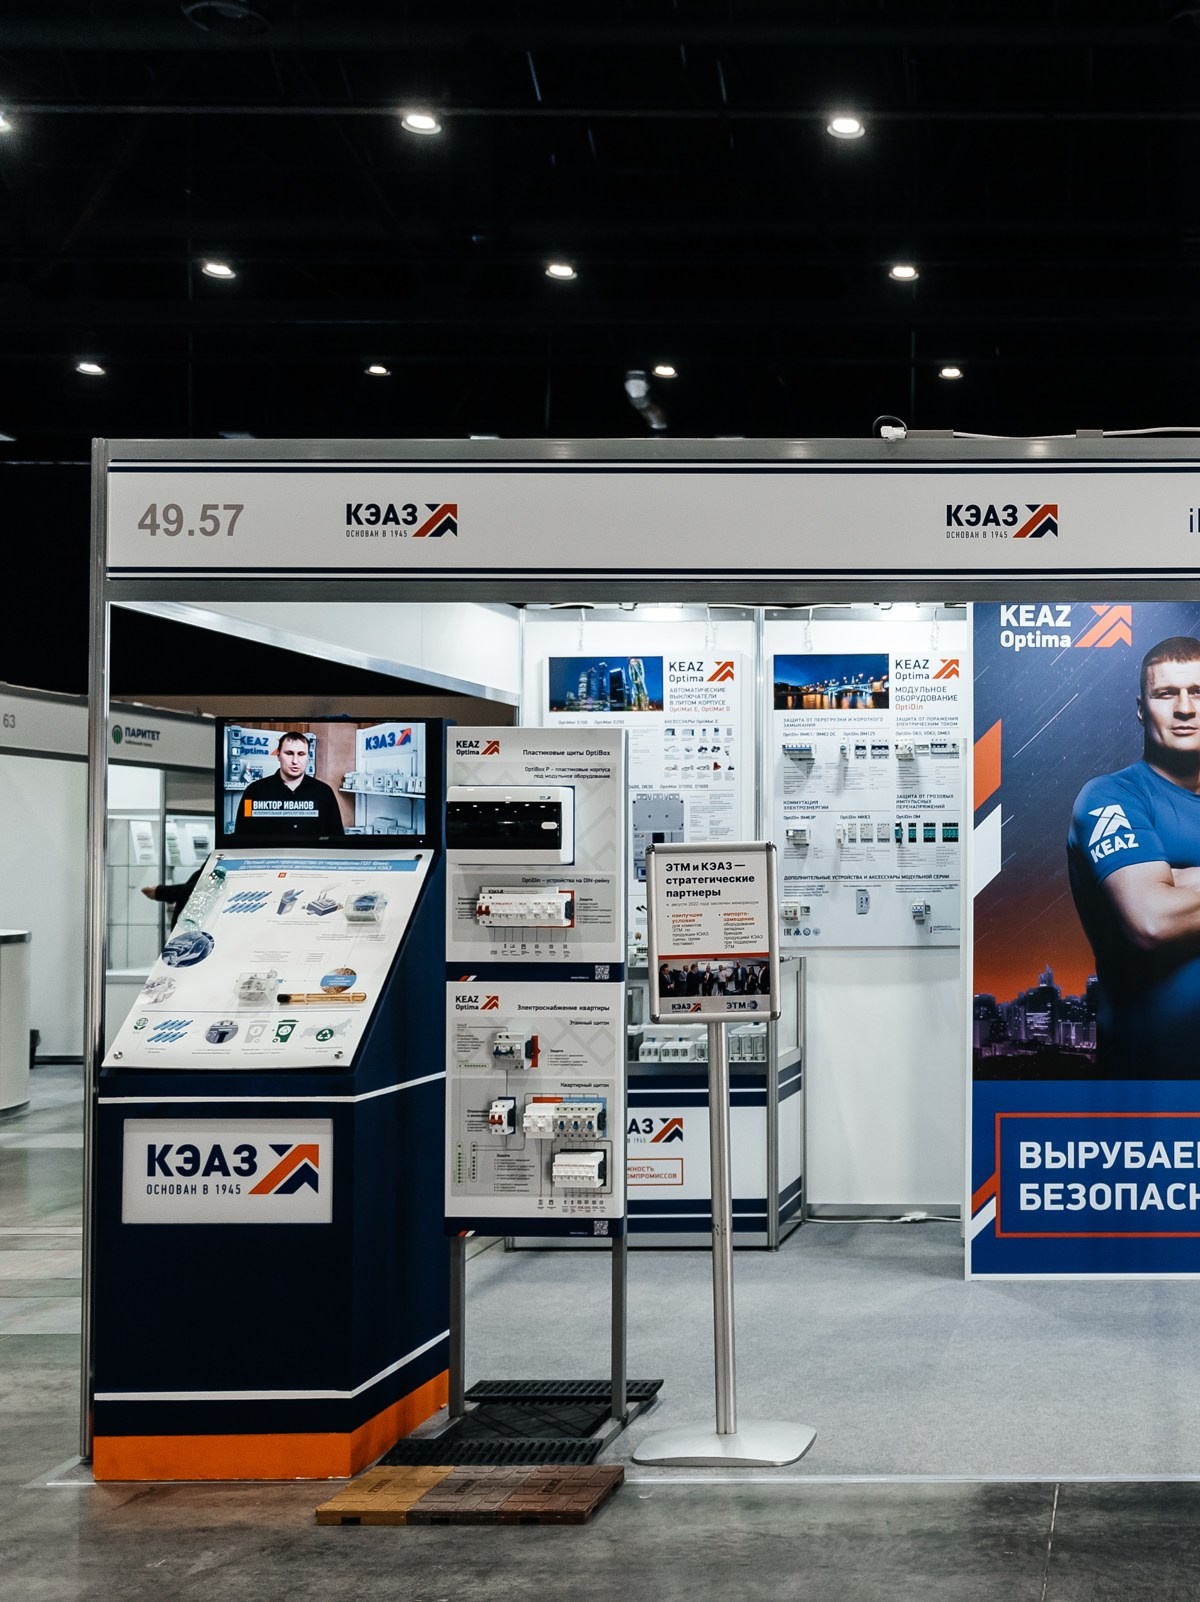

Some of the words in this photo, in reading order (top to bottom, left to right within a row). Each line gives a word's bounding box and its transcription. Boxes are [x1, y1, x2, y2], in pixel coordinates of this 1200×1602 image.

[137, 503, 245, 537] 49.57
[345, 503, 418, 526] КЭАЗ
[946, 504, 1018, 527] КЭАЗ
[345, 530, 378, 538] ОСНОВАН
[381, 530, 387, 538] В
[390, 530, 408, 538] 1945
[946, 531, 980, 539] ОСНОВАН
[982, 531, 987, 539] В
[990, 531, 1008, 539] 1945
[1000, 604, 1072, 627] KEAZ
[1000, 630, 1072, 652] Optima
[669, 661, 704, 672] KEAZ
[895, 659, 930, 670] KEAZ
[669, 674, 704, 684] Optima
[895, 671, 930, 682] Optima
[895, 686, 947, 694] МОДУЛЬНОЕ
[895, 694, 959, 703] ОБОРУДОВАНИЕ
[3, 713, 16, 728] 63
[124, 726, 161, 741] ПАРИТЕТ
[240, 735, 269, 747] KEAZ
[365, 731, 396, 751] КЭАЗ
[456, 740, 480, 748] KEAZ
[253, 800, 283, 810] ВИКТОР
[283, 800, 314, 810] ИВАНОВ
[1090, 833, 1140, 864] KEAZ
[665, 862, 691, 872] ЭТМ
[701, 861, 733, 871] КЭАЗ
[665, 874, 755, 887] стратегические
[666, 888, 721, 899] партнеры
[455, 995, 479, 1003] KEAZ
[455, 1003, 479, 1011] Optima
[146, 1143, 258, 1177] КЭАЗ
[146, 1184, 197, 1195] ОСНОВАН
[202, 1184, 209, 1195] В
[215, 1184, 241, 1195] 1945
